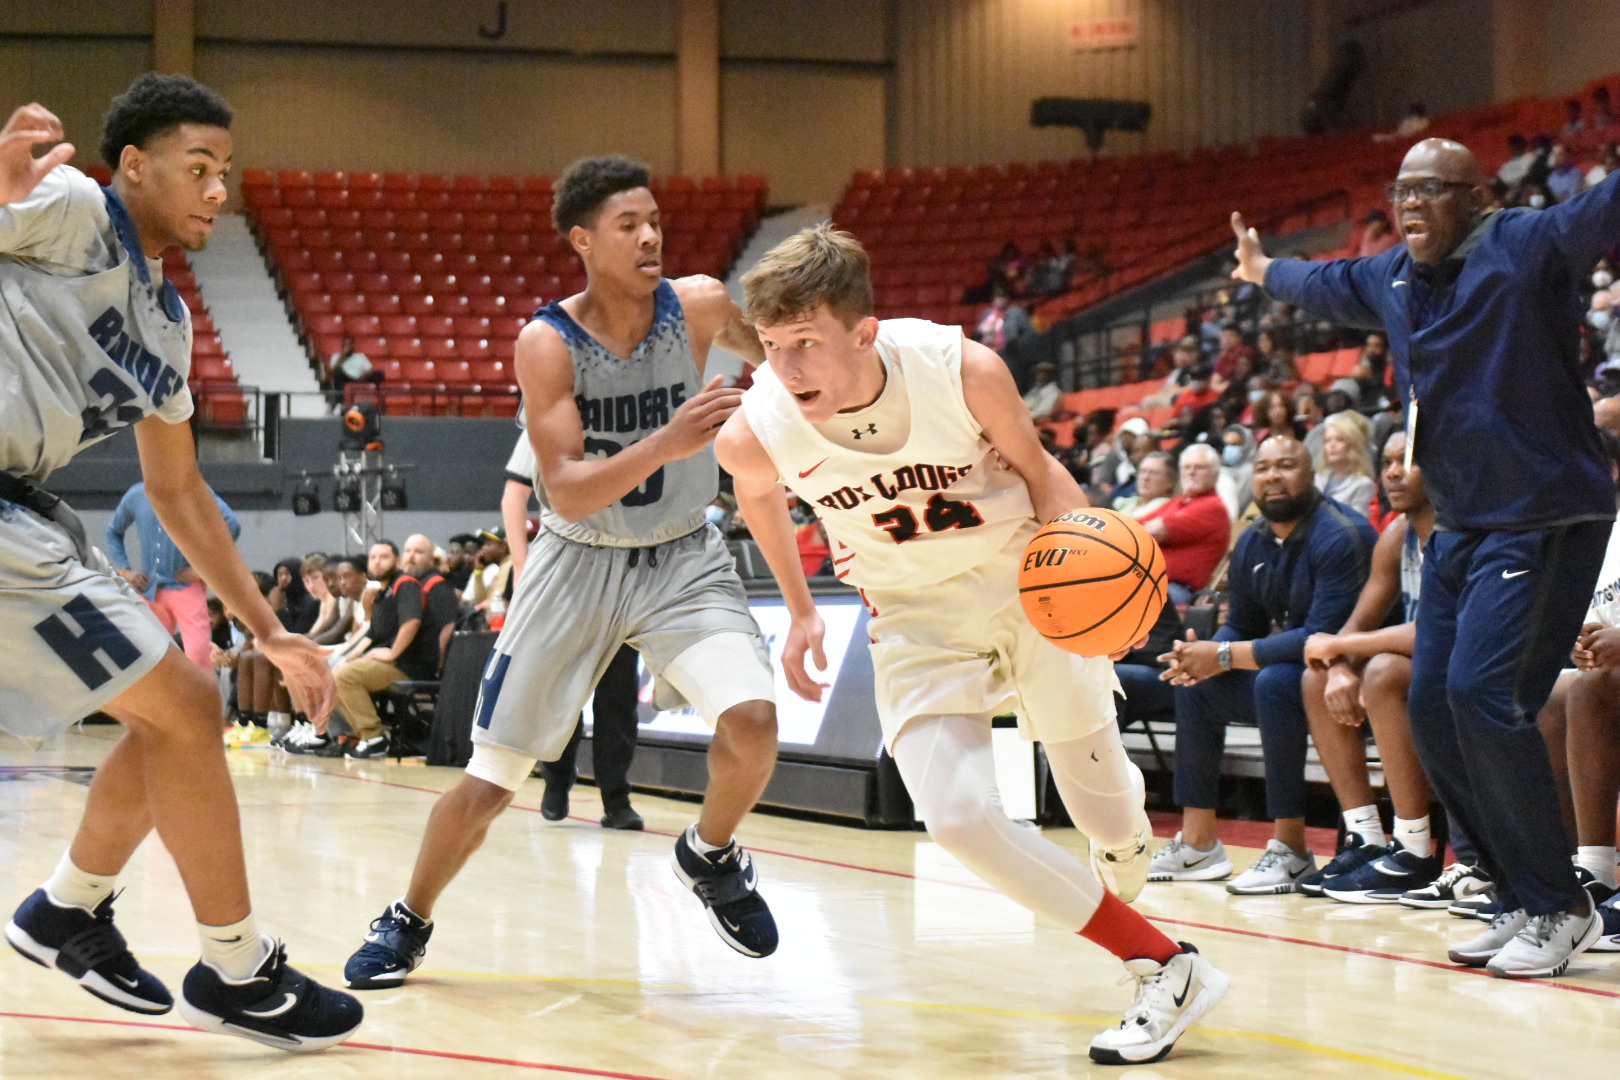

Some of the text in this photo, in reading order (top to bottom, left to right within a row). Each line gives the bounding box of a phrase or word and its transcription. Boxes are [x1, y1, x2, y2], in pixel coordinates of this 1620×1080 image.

[871, 493, 985, 545] 24
[1068, 548, 1089, 556] NXT
[33, 592, 143, 692] H
